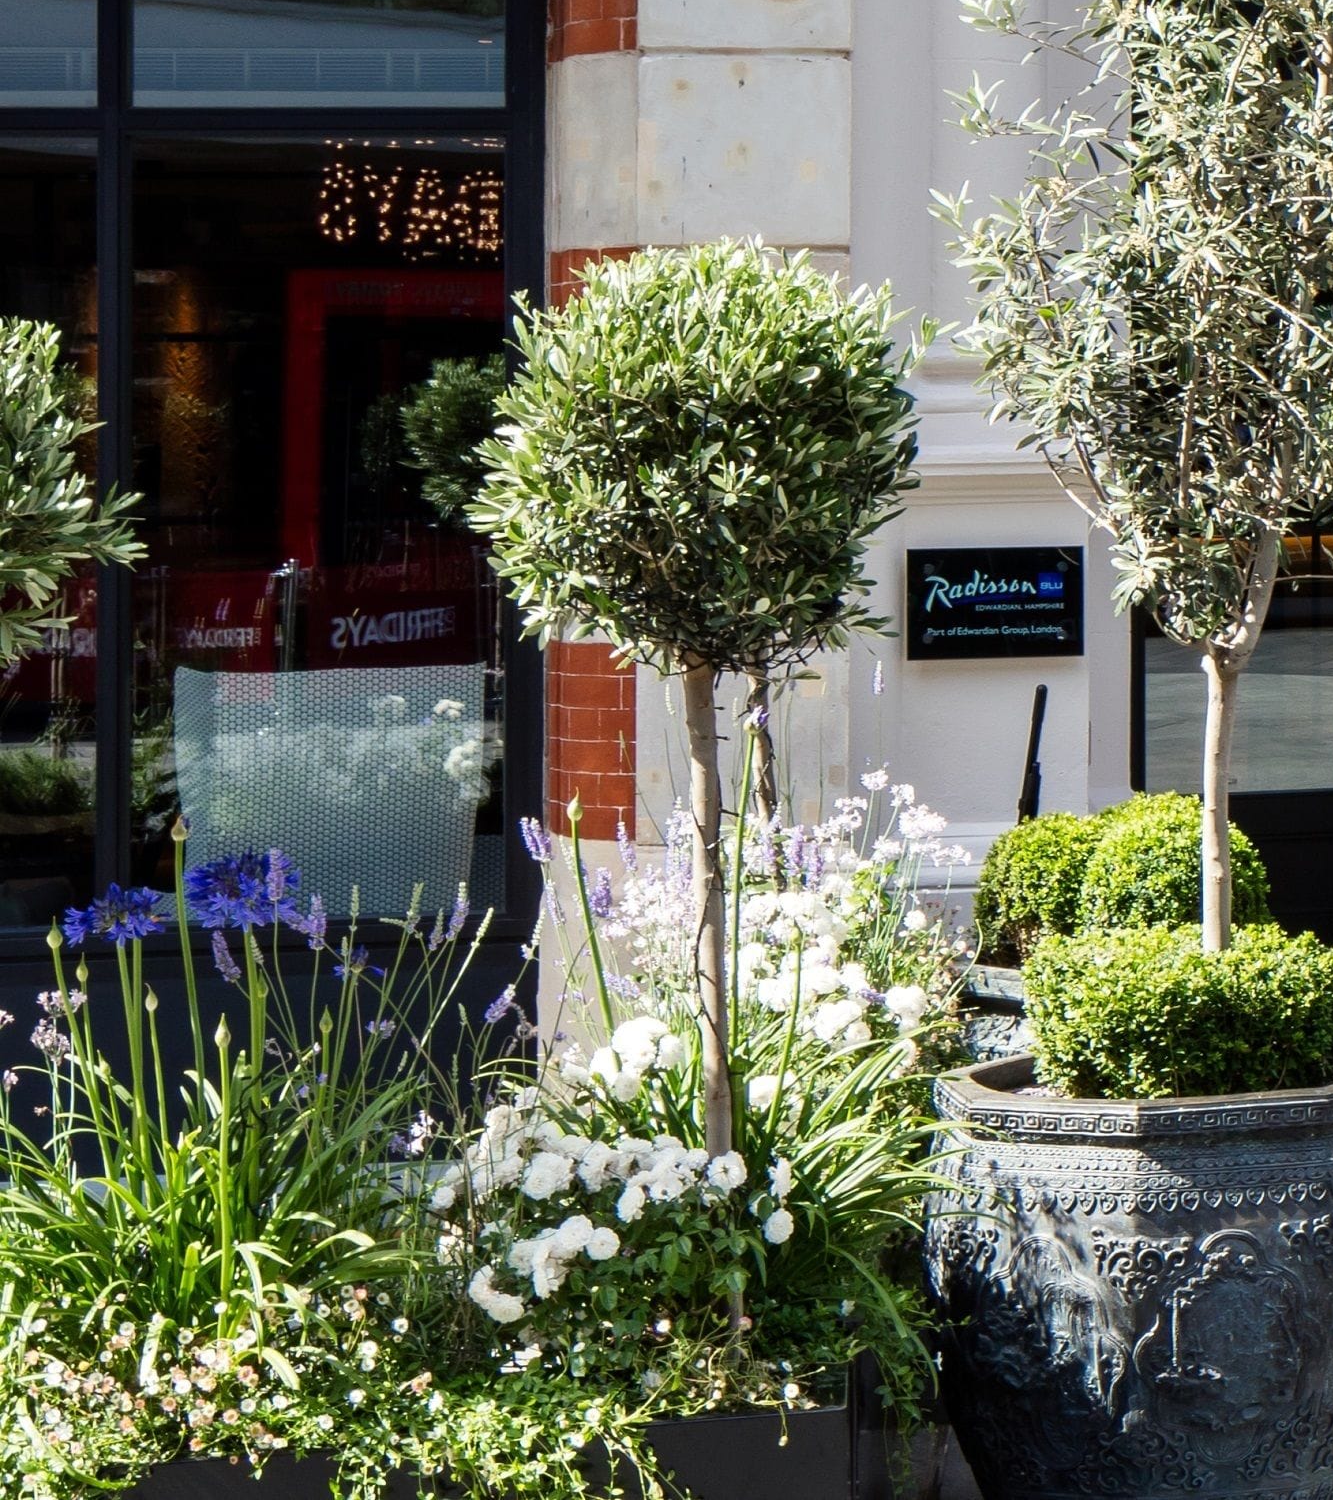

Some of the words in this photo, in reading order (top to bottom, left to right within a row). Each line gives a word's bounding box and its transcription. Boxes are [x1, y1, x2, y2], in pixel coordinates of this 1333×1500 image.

[924, 569, 1037, 612] Radisson
[1039, 581, 1063, 590] BLU
[1024, 602, 1064, 610] HAMPSHIRE
[927, 627, 945, 636] Part
[947, 627, 957, 636] of
[957, 626, 999, 636] Edwardian
